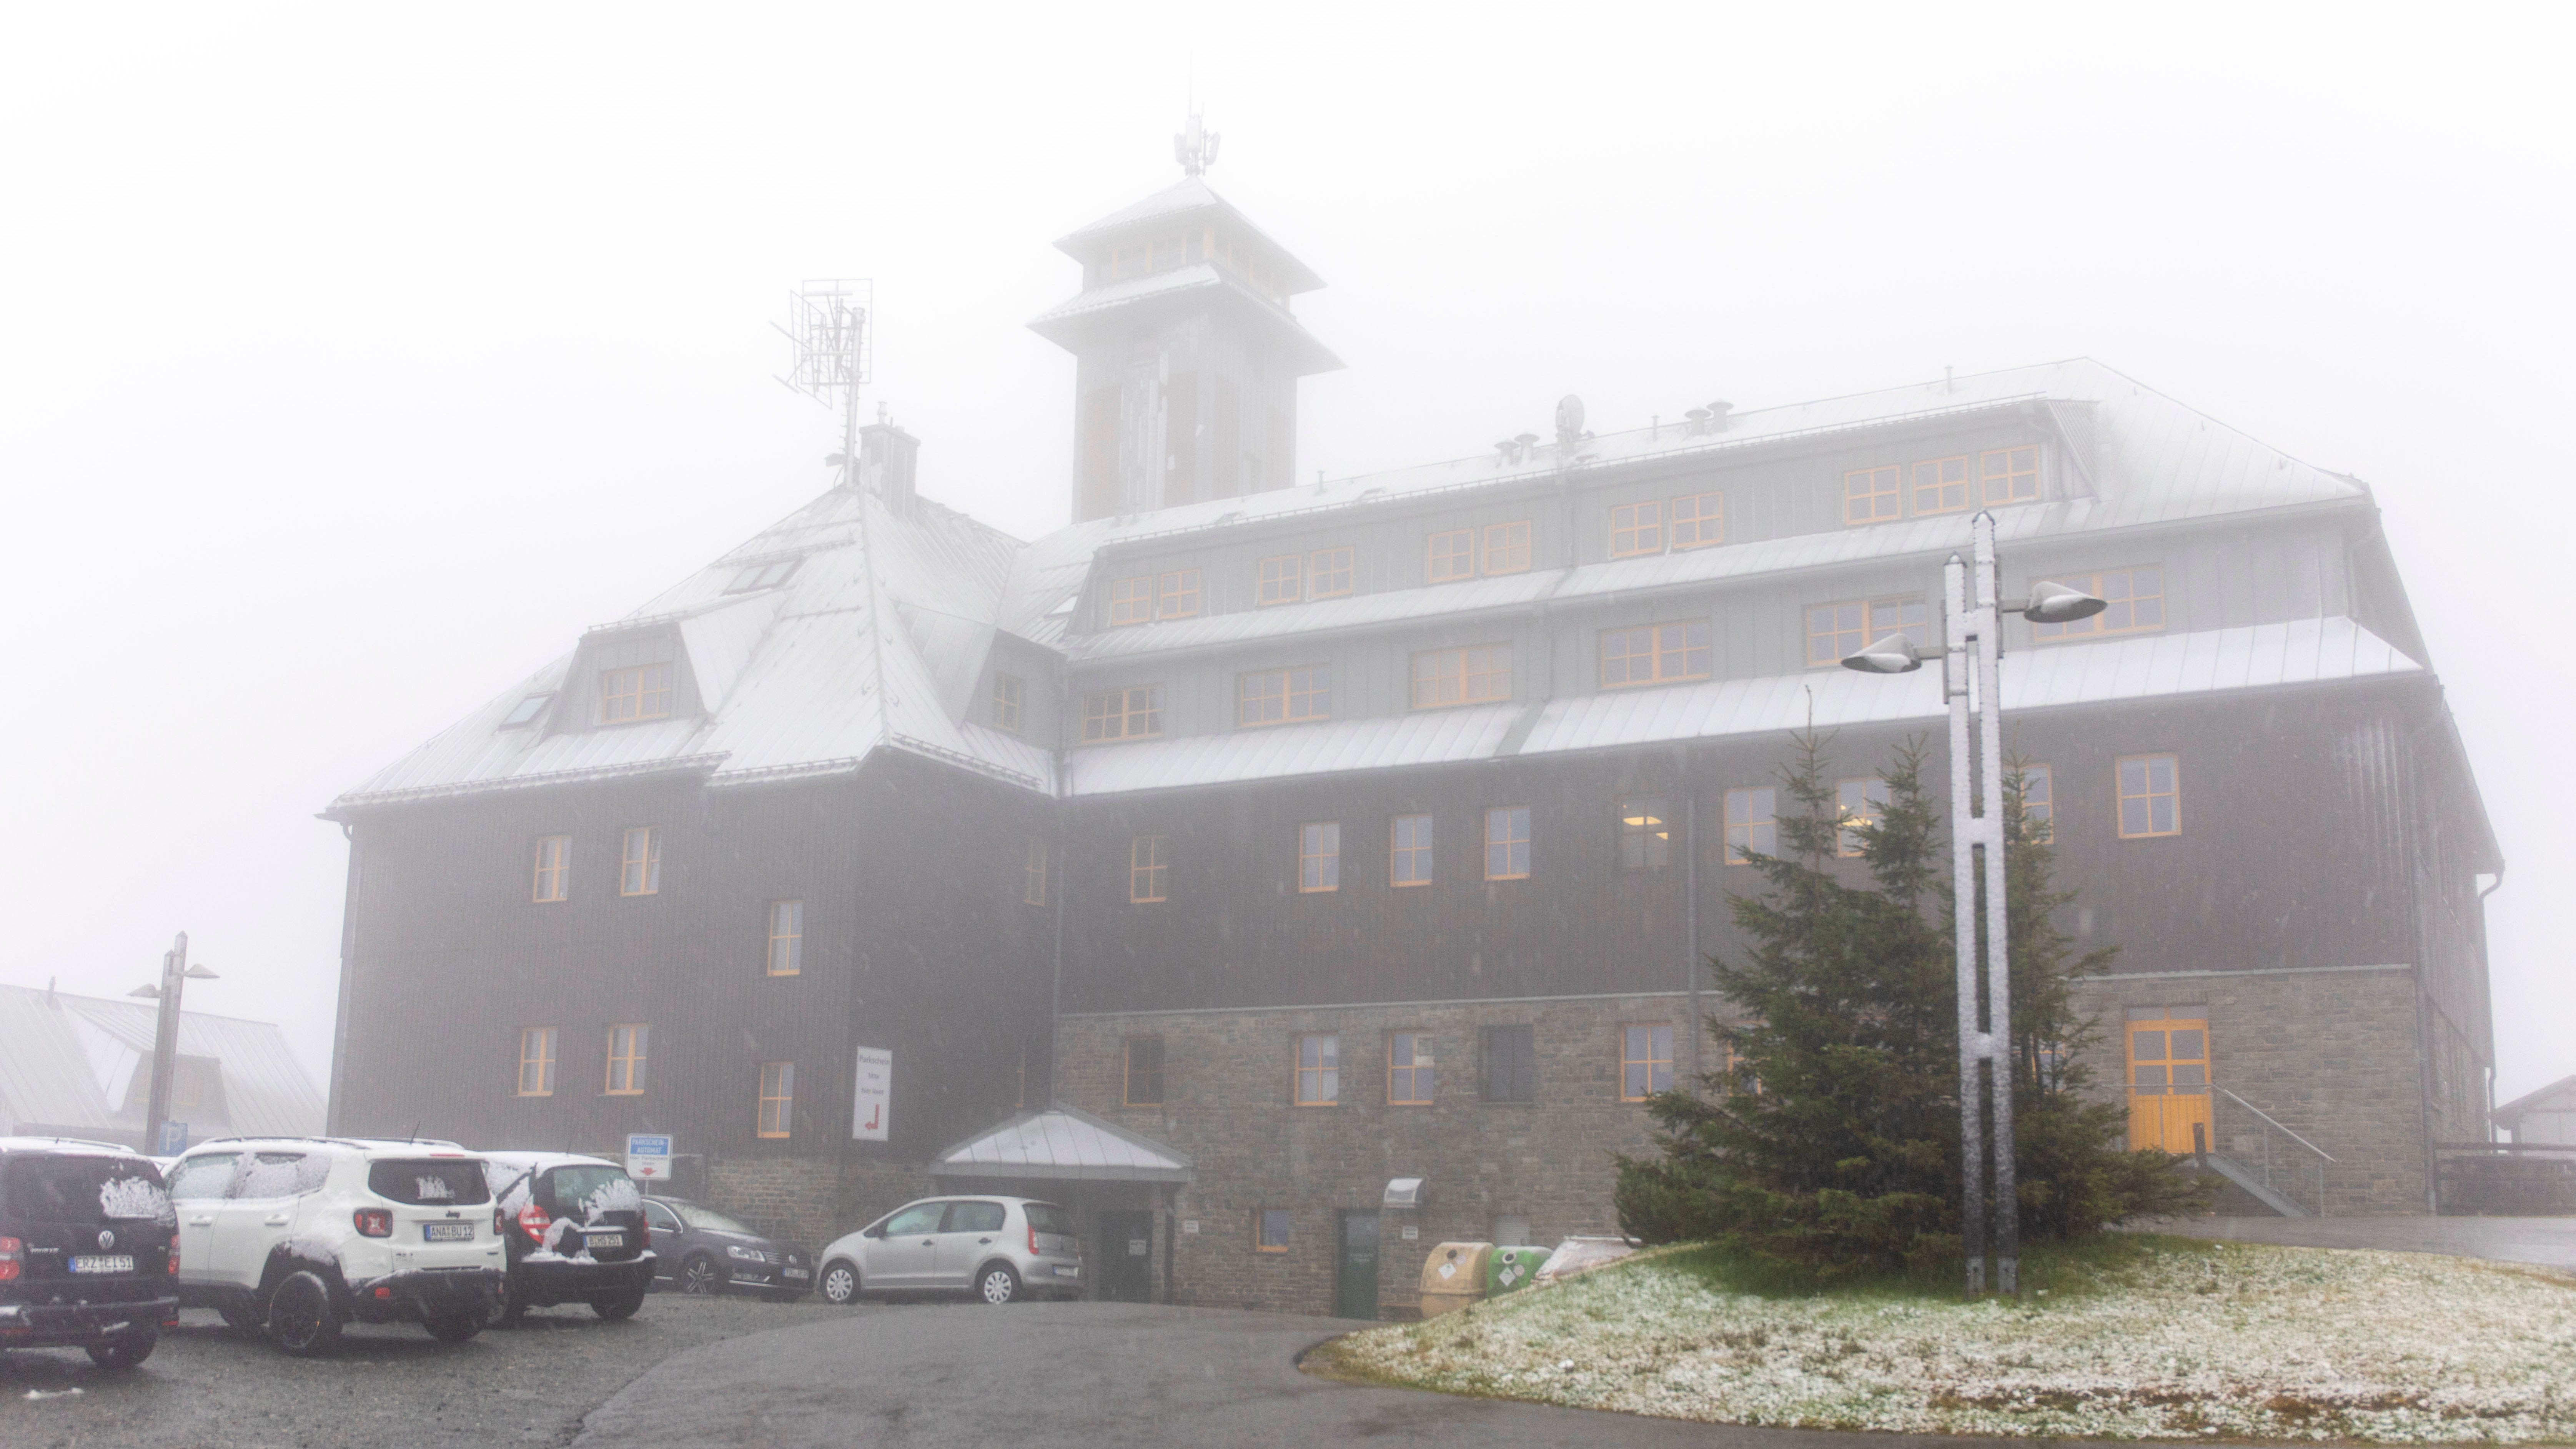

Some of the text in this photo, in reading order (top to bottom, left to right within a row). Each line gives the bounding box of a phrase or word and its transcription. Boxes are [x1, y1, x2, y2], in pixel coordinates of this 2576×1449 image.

[166, 1127, 181, 1151] P
[637, 1146, 661, 1155] AUTOMAT
[76, 1256, 97, 1269] ERZ
